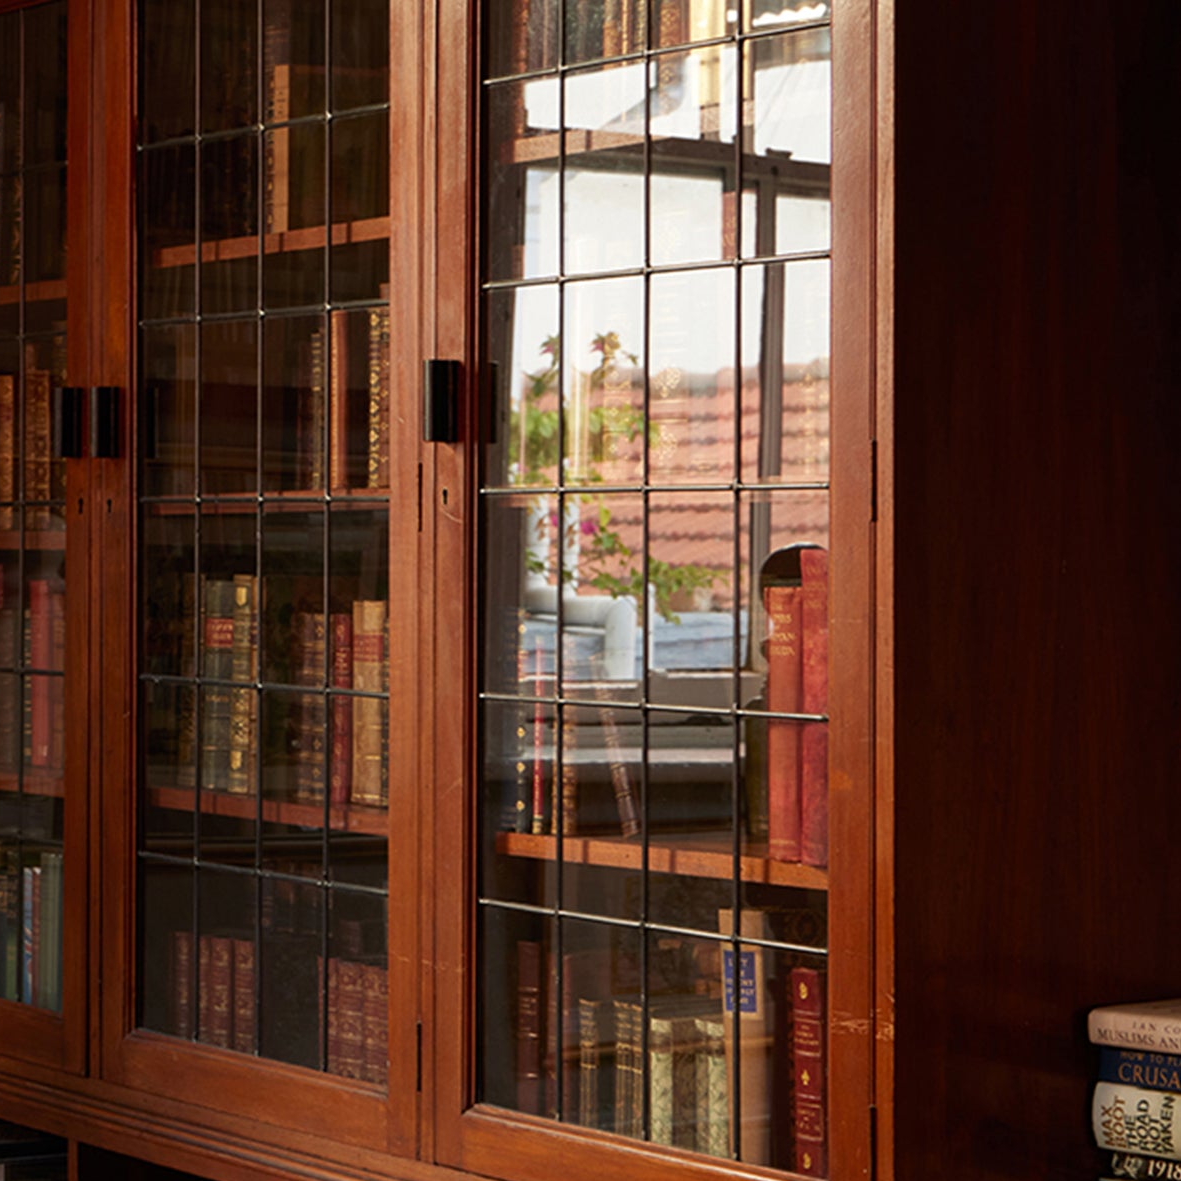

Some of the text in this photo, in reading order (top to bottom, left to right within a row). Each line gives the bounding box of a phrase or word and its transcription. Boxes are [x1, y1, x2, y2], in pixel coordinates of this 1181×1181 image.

[1097, 1028, 1155, 1046] MUSLIMS
[1117, 1062, 1181, 1090] CRUSA
[1100, 1104, 1116, 1147] MAX
[1112, 1095, 1127, 1149] BOOT
[1124, 1114, 1138, 1148] THE
[1136, 1099, 1150, 1152] ROAD
[1148, 1117, 1163, 1153] NOT
[1160, 1095, 1176, 1153] TAKEN
[1147, 1158, 1181, 1181] 1918
